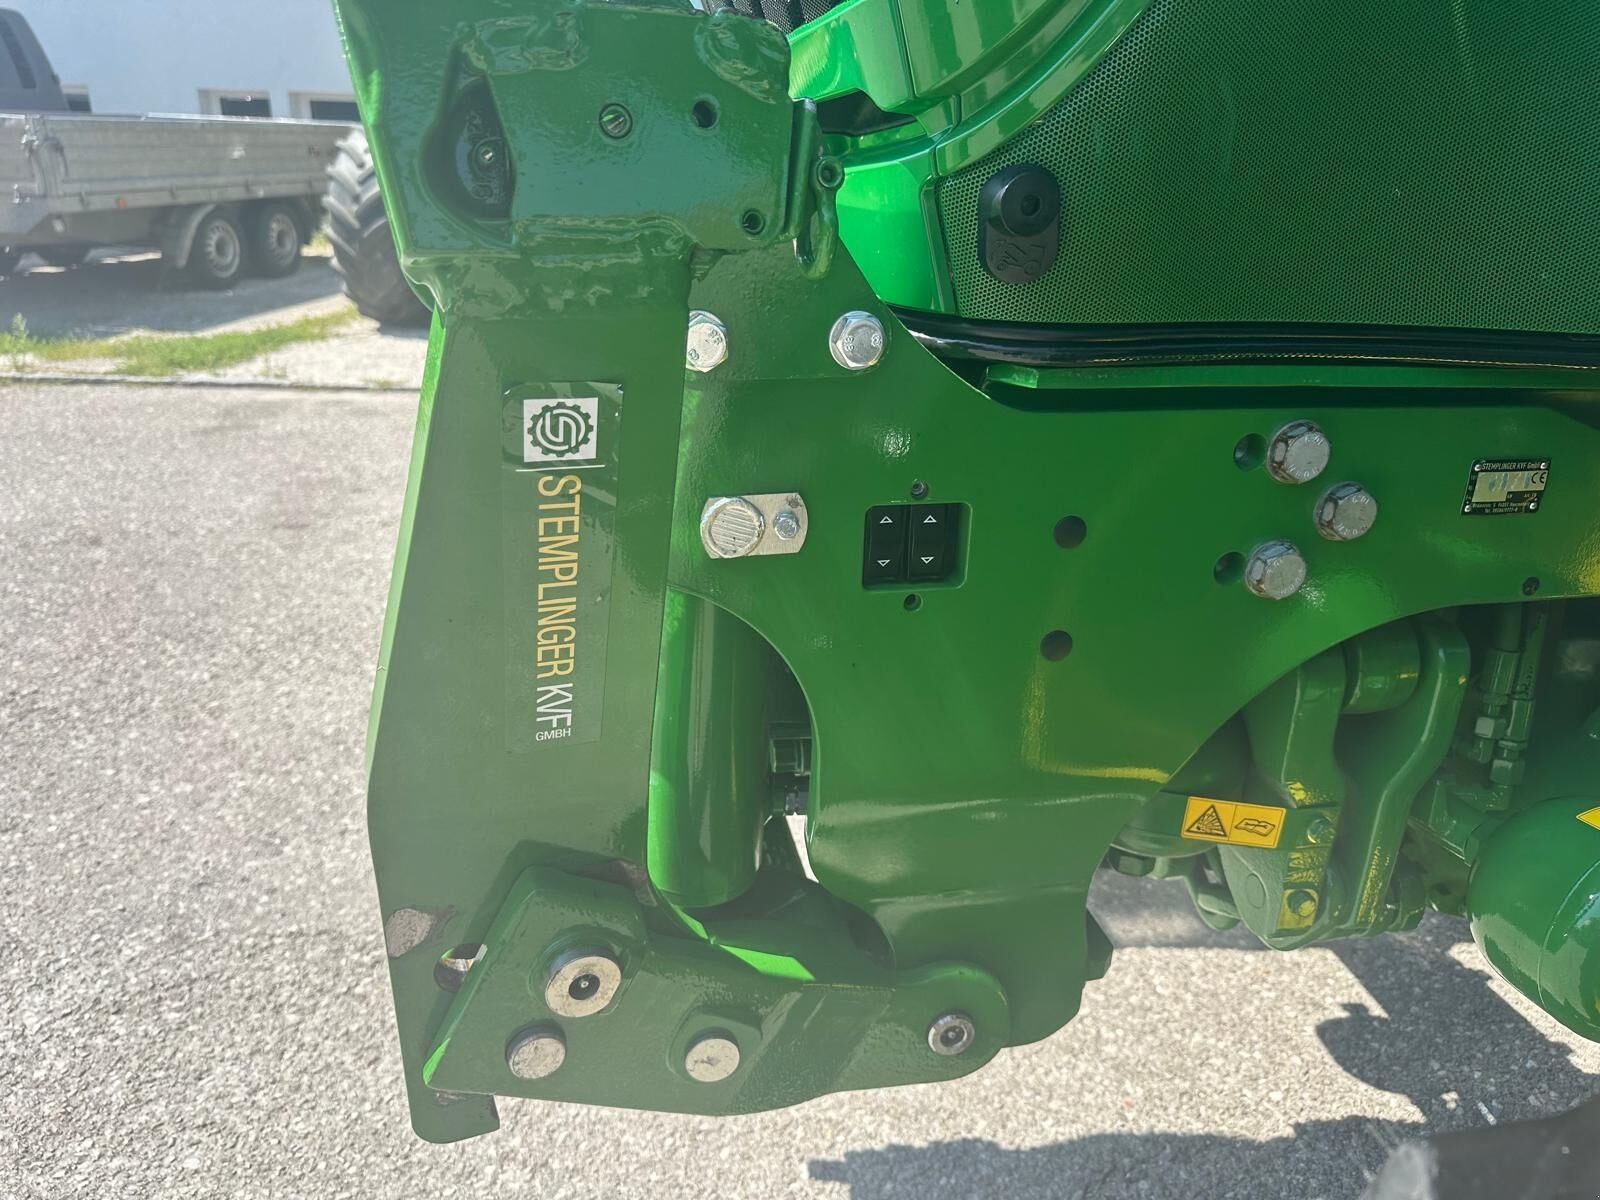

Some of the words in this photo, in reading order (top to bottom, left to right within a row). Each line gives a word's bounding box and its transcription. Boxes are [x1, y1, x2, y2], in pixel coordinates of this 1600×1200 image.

[537, 474, 582, 679] STEMPLINGER
[536, 683, 573, 728] KVF
[535, 727, 571, 741] GMBH
